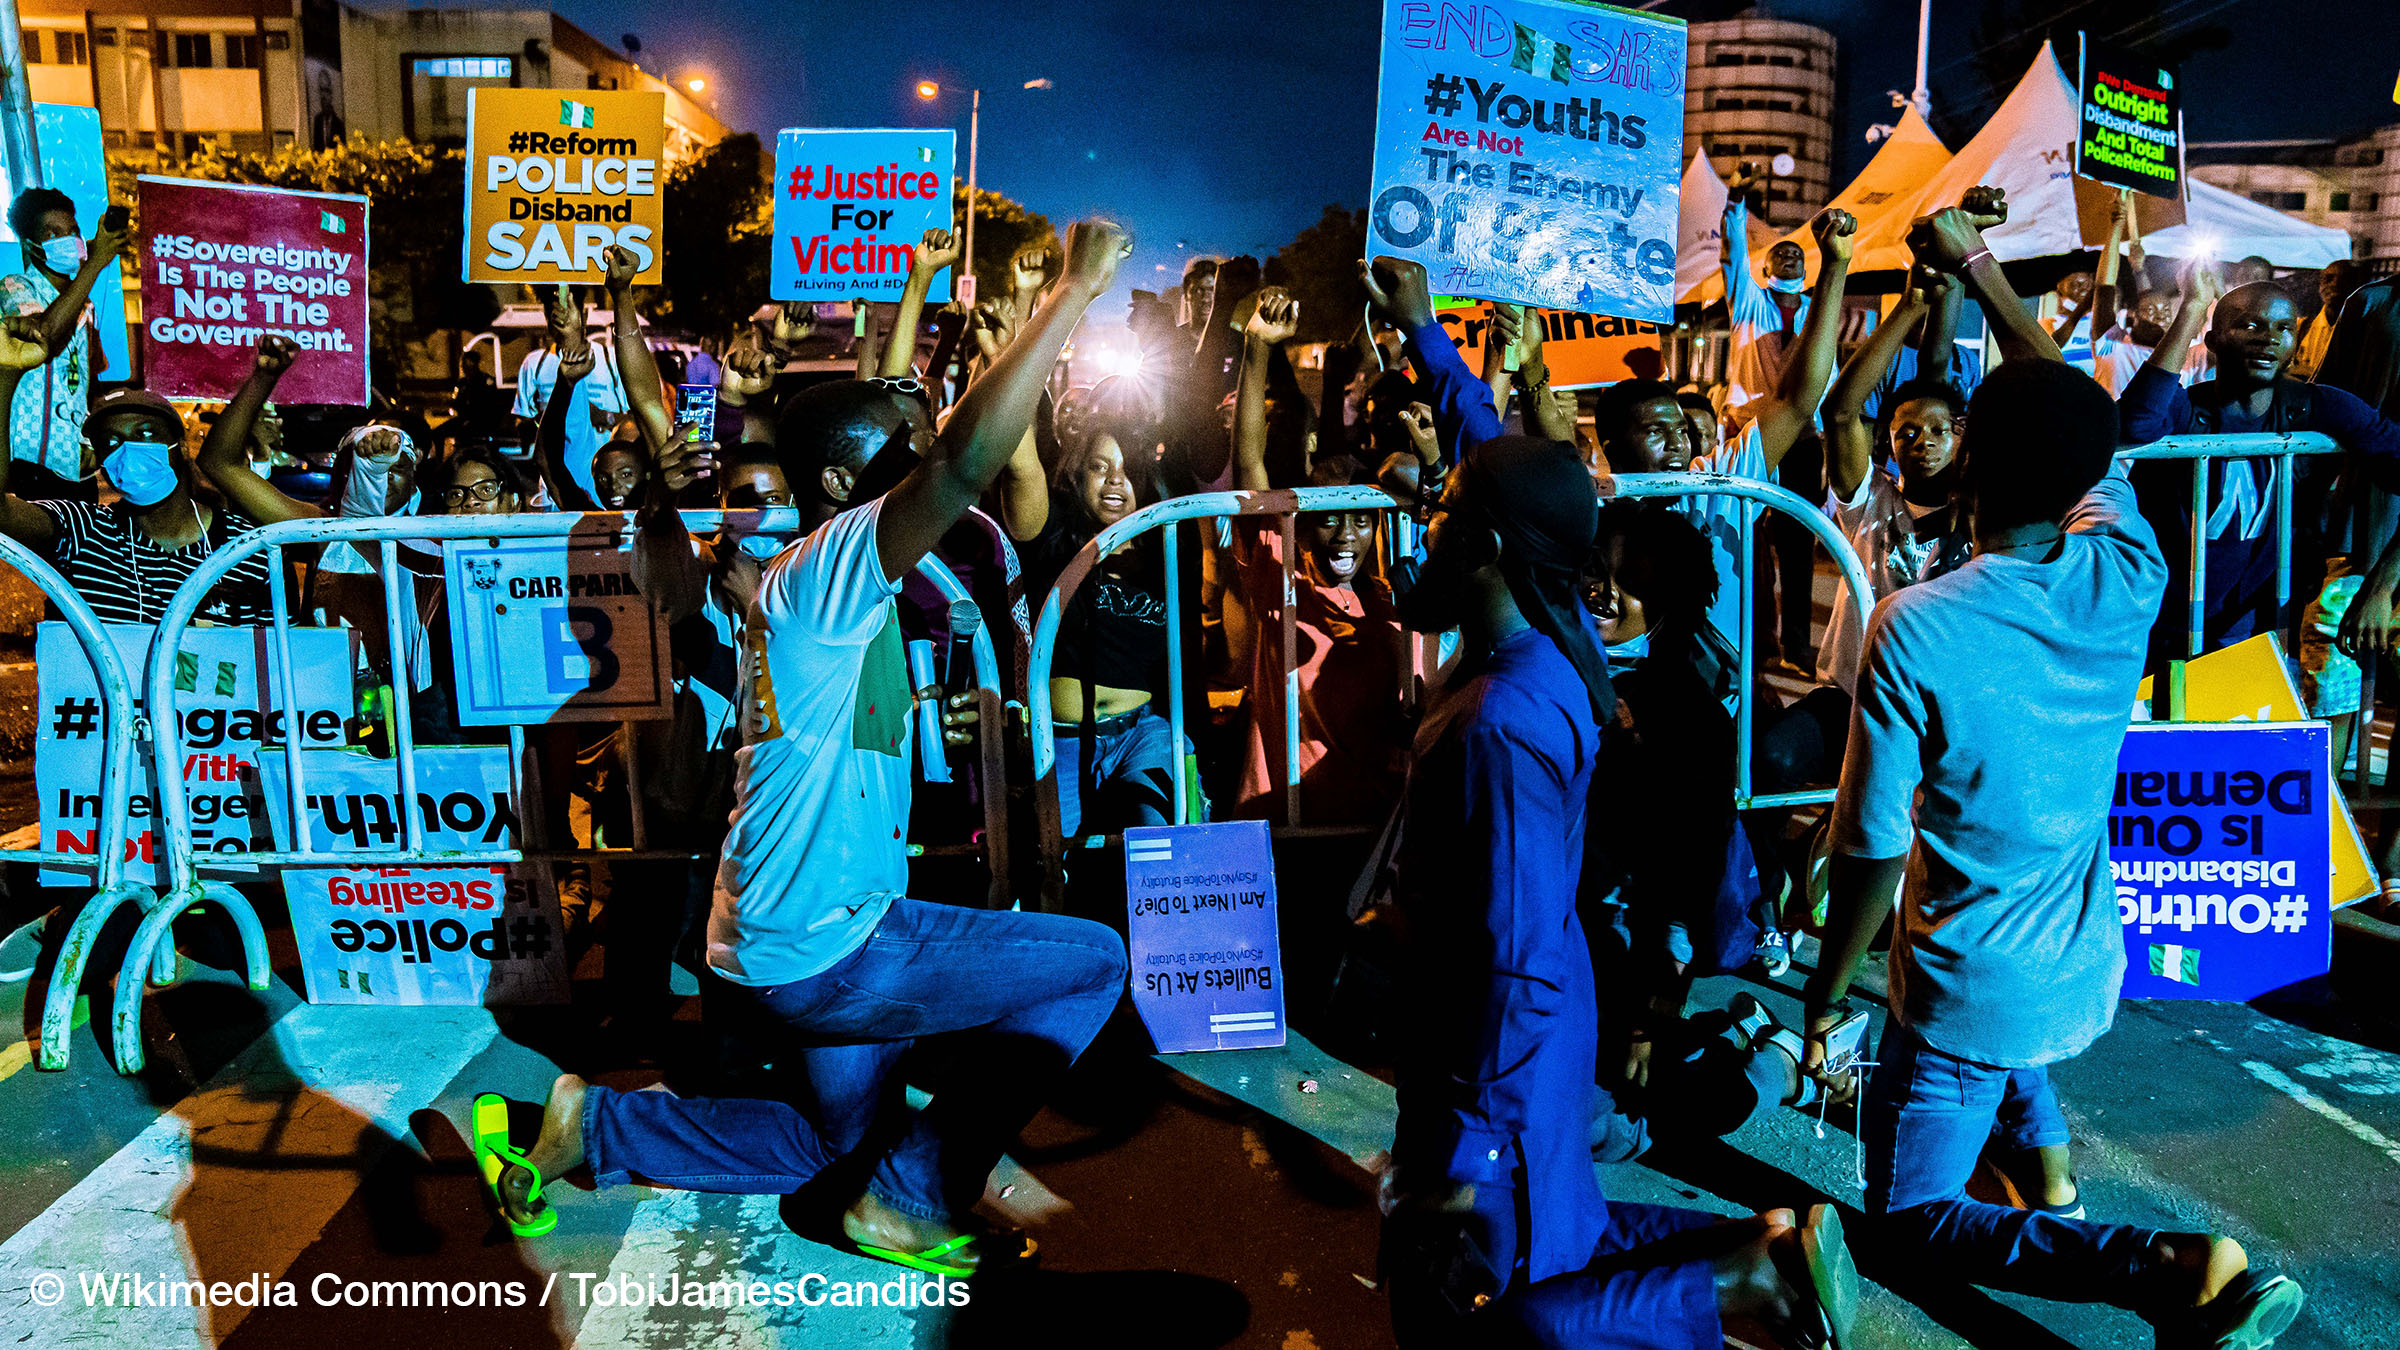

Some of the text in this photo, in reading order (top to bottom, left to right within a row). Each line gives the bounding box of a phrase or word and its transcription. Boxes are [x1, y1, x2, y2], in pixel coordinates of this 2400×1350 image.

[1400, 2, 1681, 98] END SARS
[2093, 82, 2169, 125] Outright
[2122, 78, 2167, 103] Demand
[1423, 73, 1648, 149] #Youths
[2084, 102, 2177, 148] Disbandment
[508, 131, 637, 156] #Reform
[1421, 121, 1525, 157] Are Not
[2095, 126, 2166, 162] And Total
[487, 155, 656, 195] POLICE
[2084, 139, 2176, 182] PoliceReform
[788, 162, 940, 200] #Justice
[1419, 147, 1645, 218] The Enemy
[509, 197, 632, 222] Disband
[831, 203, 894, 231] For
[151, 232, 353, 275] #Sovereignty
[485, 221, 654, 273] SARS
[1372, 185, 1678, 287] Of Ste
[157, 261, 351, 299] Is The People
[794, 278, 846, 292] #Living
[850, 278, 880, 290] And
[173, 287, 330, 327] Not The
[149, 316, 354, 352] Governent.
[508, 576, 564, 599] CAR
[540, 606, 622, 695] B
[306, 791, 524, 848] Youth.
[2220, 814, 2263, 855] Is
[327, 876, 541, 914] Is Stealing
[1140, 870, 1258, 889] #SayNoToPolice Brutality
[1134, 890, 1266, 917] Am I Next To Die?
[330, 917, 551, 964] #Police
[1145, 948, 1264, 967] #SayNoToPolice Brutality
[1145, 966, 1273, 997] Bullets At Us
